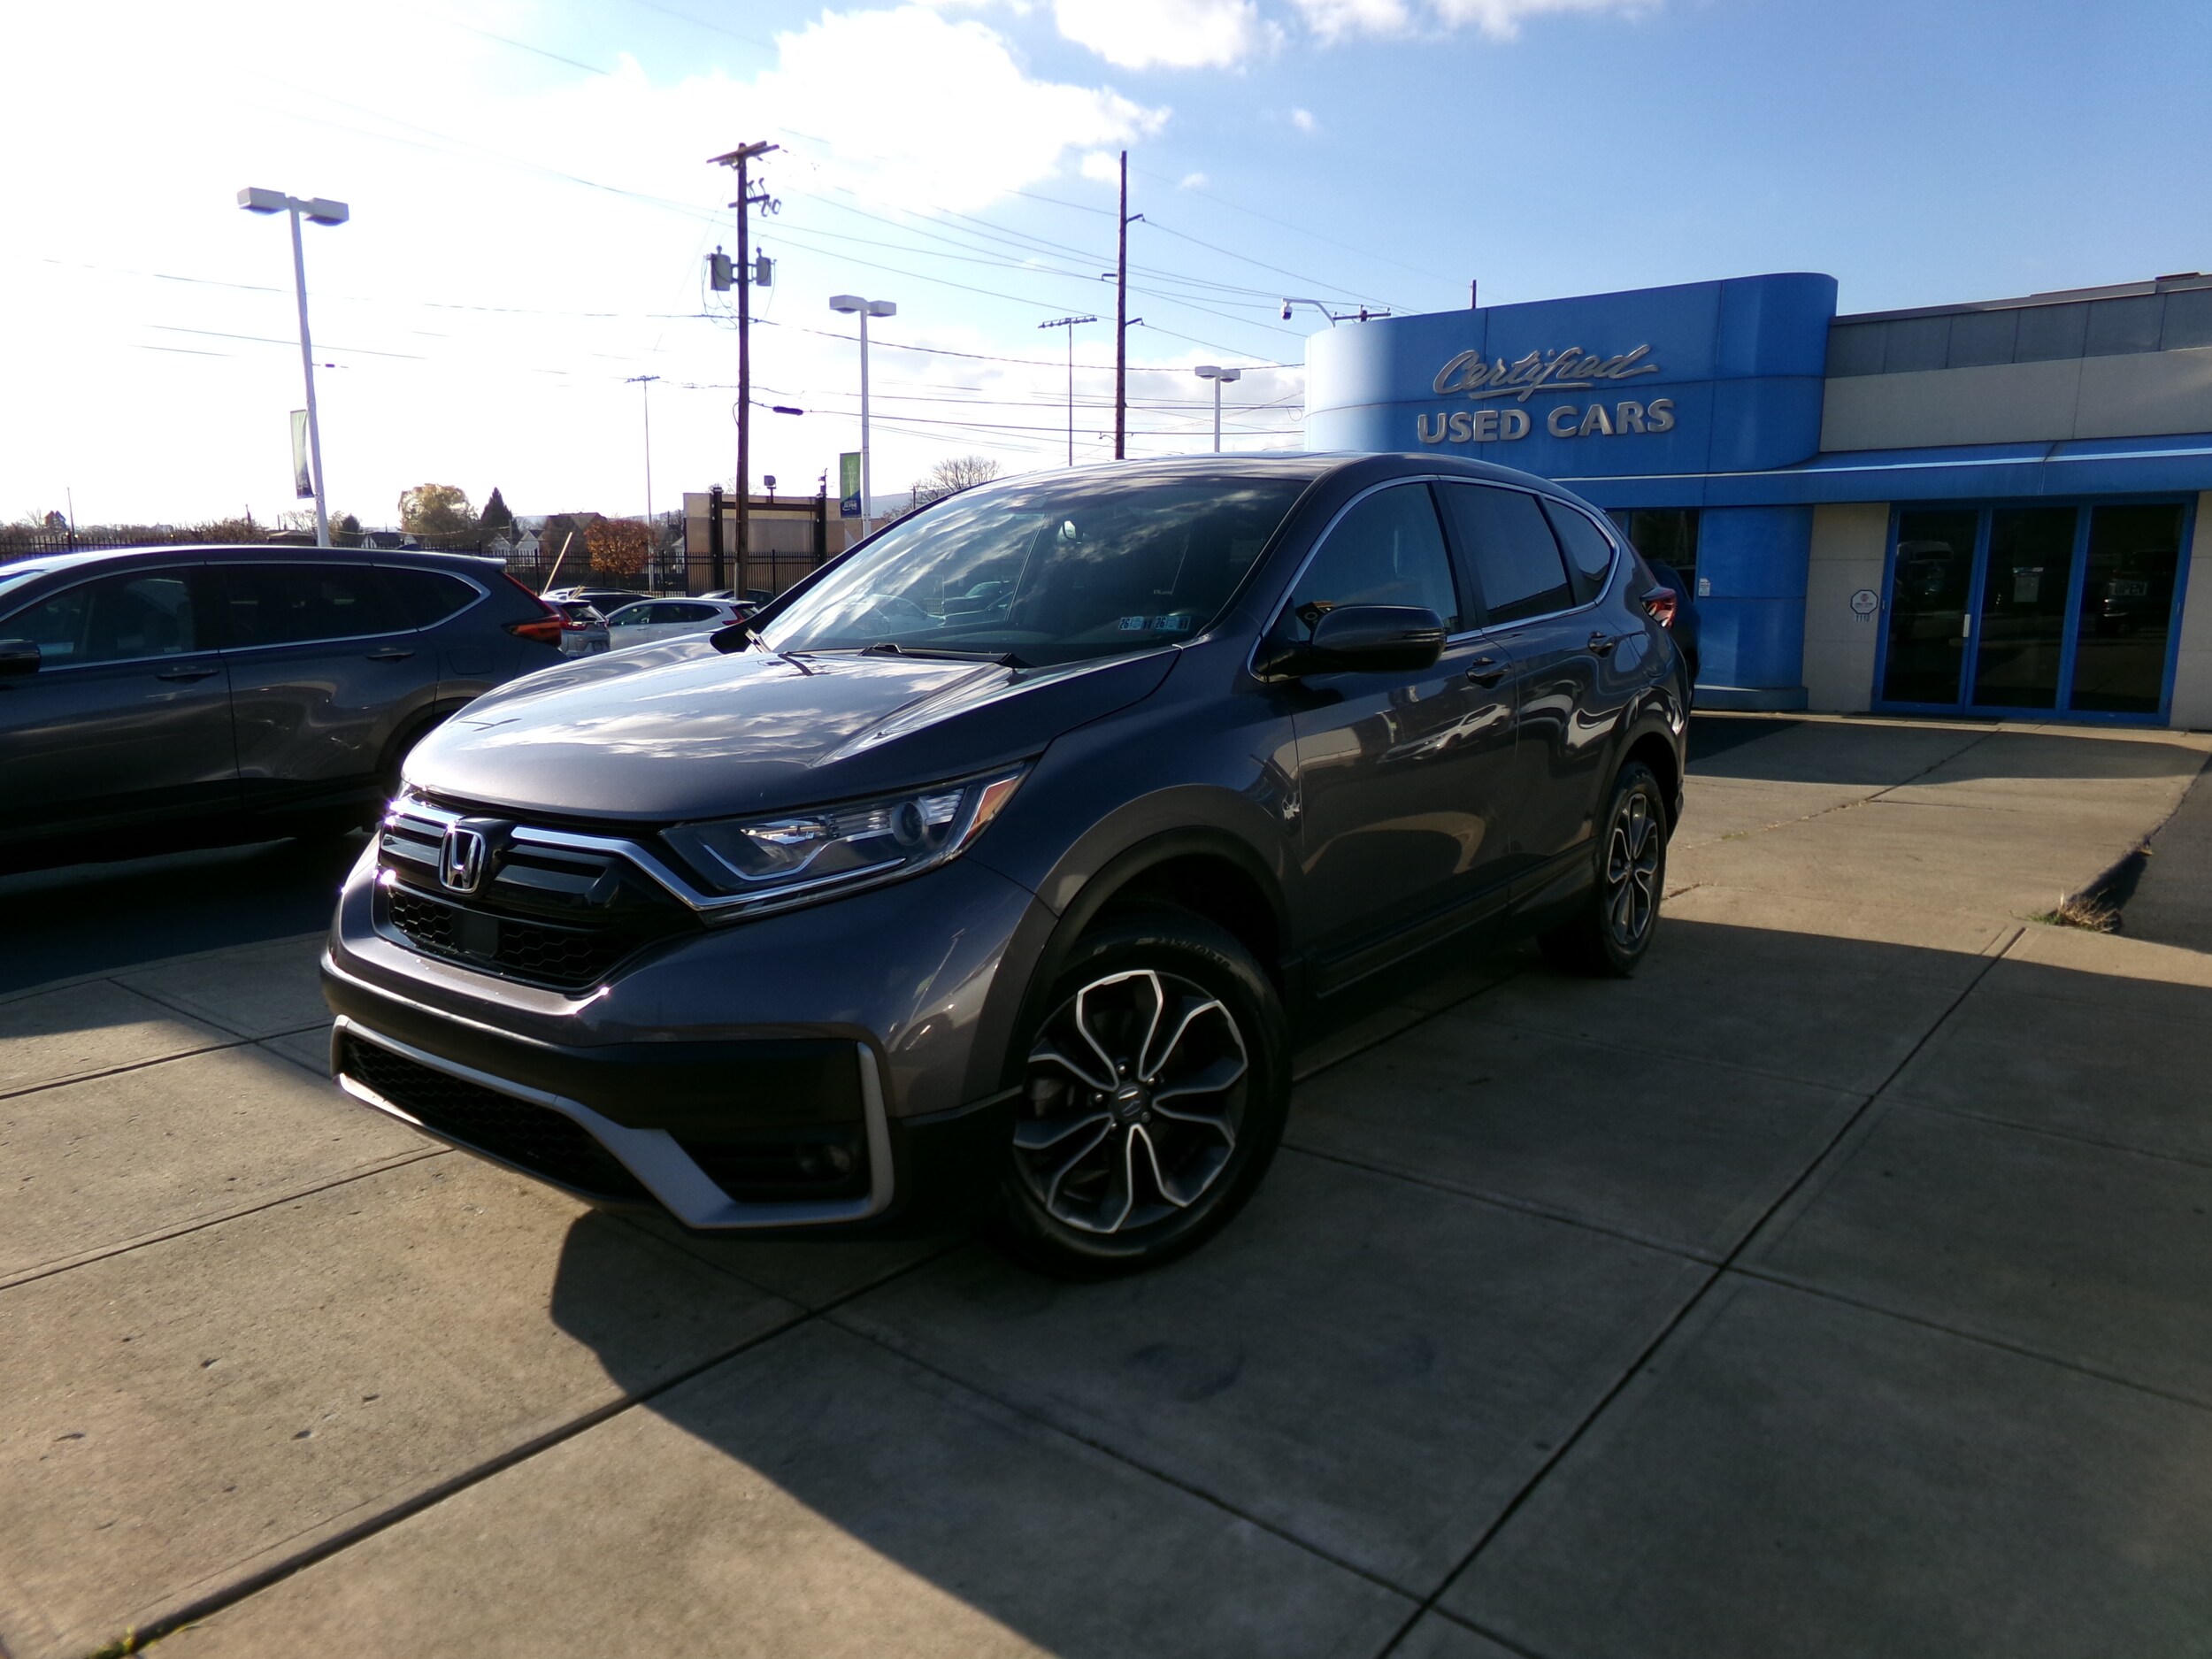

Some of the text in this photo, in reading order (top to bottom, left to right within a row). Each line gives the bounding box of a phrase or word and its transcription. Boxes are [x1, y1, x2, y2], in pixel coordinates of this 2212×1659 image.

[1432, 343, 1658, 402] Certified
[1417, 398, 1675, 443] USED CARS
[2115, 581, 2145, 595] OPEN
[1119, 618, 1130, 629] 26
[1155, 617, 1166, 628] 26
